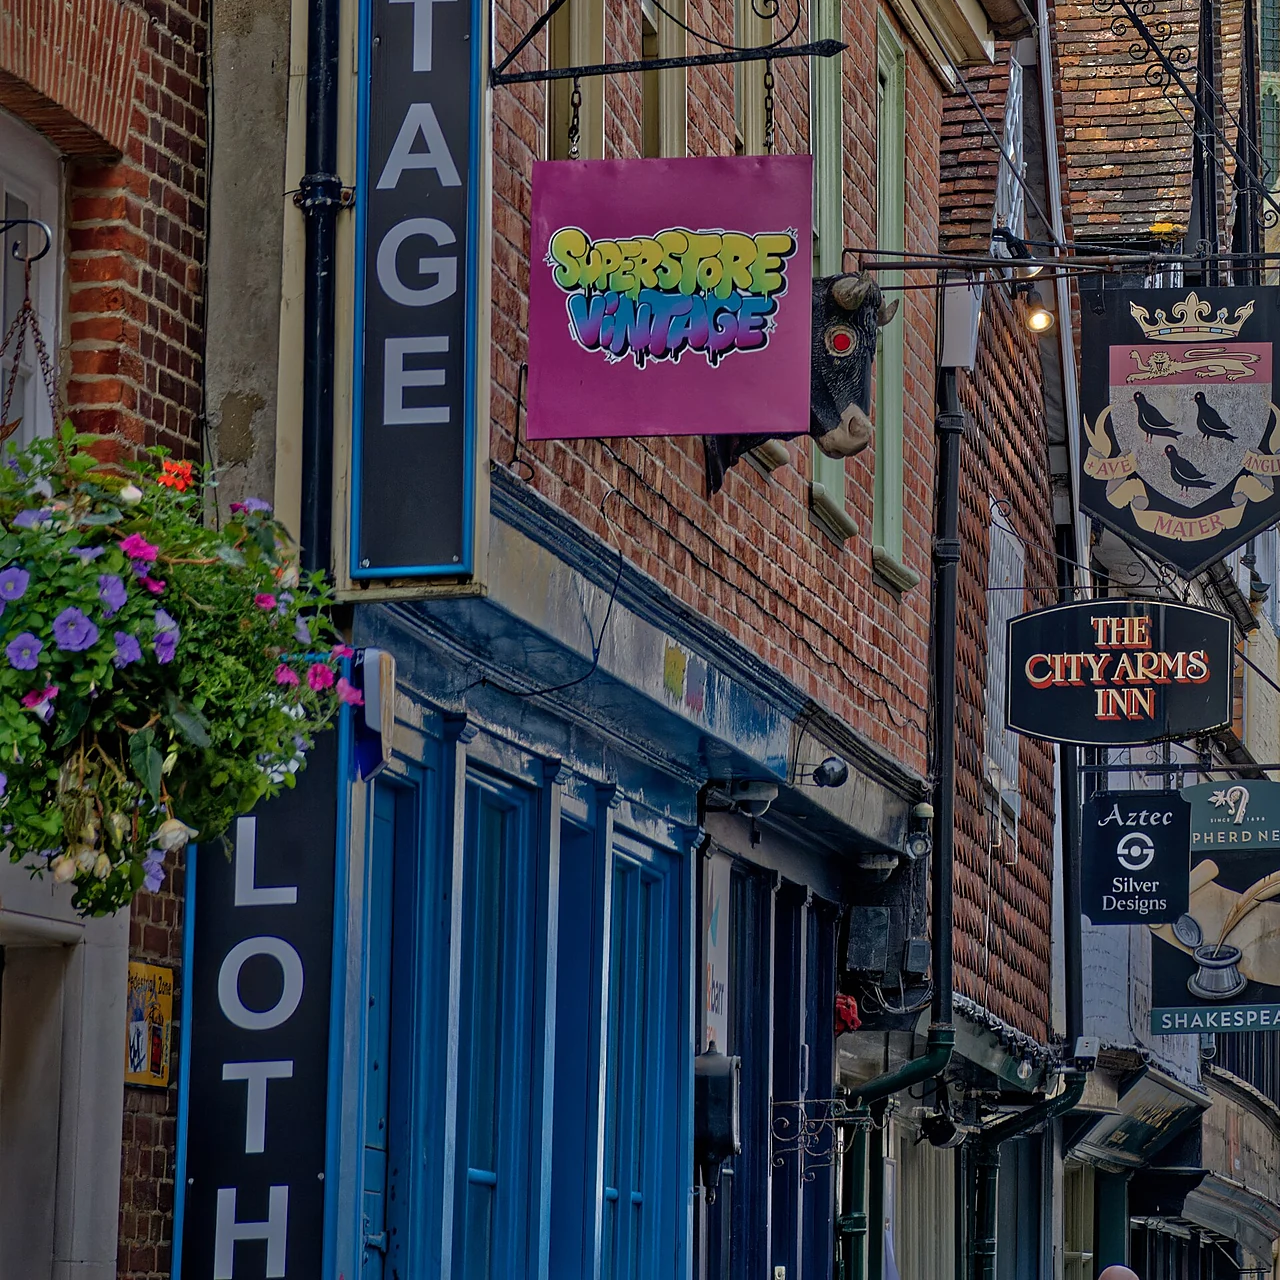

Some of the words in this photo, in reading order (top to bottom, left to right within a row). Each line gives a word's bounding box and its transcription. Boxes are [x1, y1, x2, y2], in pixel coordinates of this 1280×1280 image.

[550, 227, 799, 298] SUPERSTORE
[1096, 458, 1133, 477] AVE
[1153, 513, 1226, 538] MATER
[1090, 615, 1153, 650] THE
[1024, 651, 1114, 690] CITY
[1111, 649, 1211, 685] ARMS
[1094, 687, 1156, 721] INN
[1097, 803, 1174, 827] Aztec
[1192, 831, 1252, 844] PHERD
[1112, 877, 1160, 893] Silver
[1102, 895, 1167, 915] Designs
[214, 816, 306, 1280] LOTH
